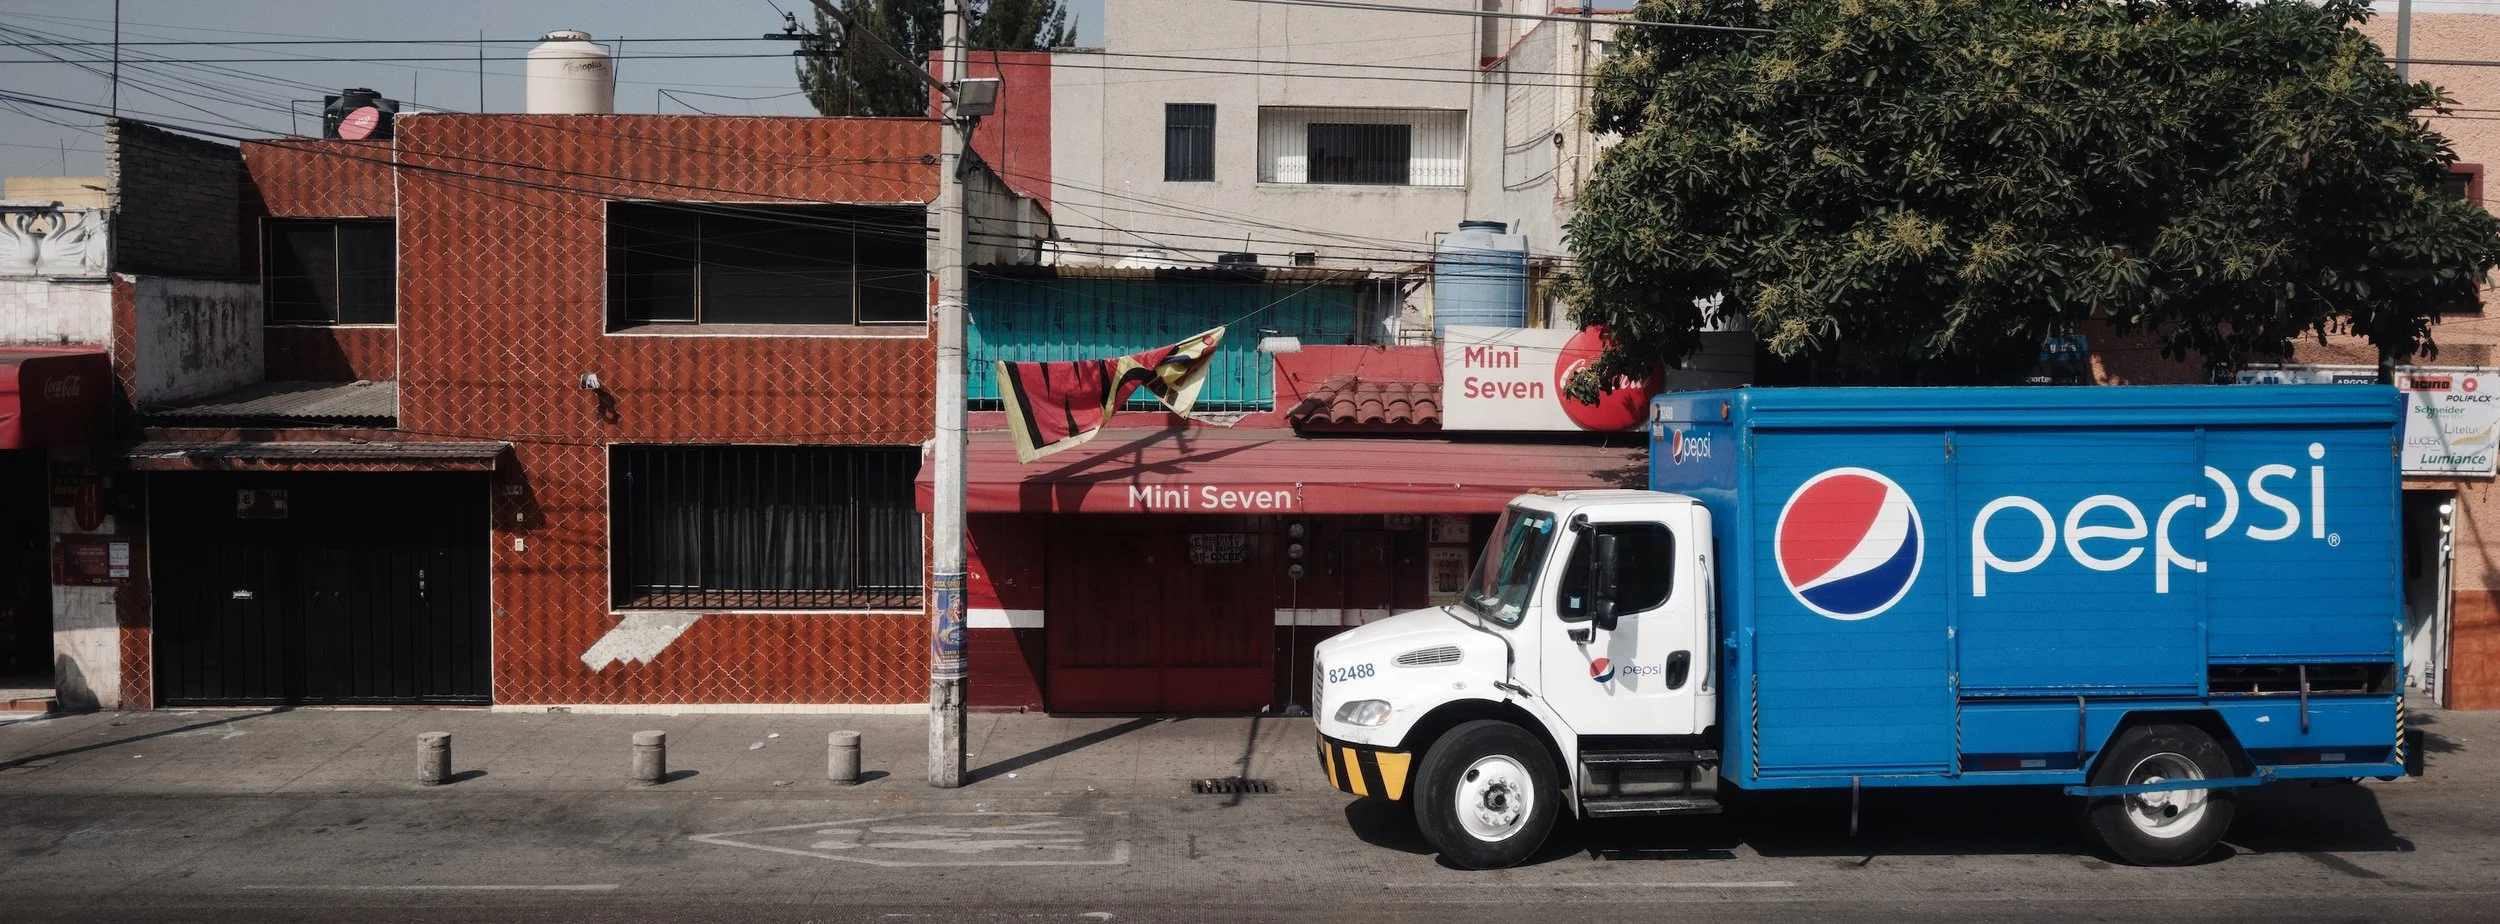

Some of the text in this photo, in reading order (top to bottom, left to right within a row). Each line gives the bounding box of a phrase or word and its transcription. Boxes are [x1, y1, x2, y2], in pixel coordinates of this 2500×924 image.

[1465, 345, 1518, 368] Mini
[1464, 376, 1543, 399] Seven
[2414, 405, 2466, 414] Schneider
[1684, 432, 1711, 463] pepsi
[2421, 453, 2486, 465] Lumiance
[1129, 485, 1291, 509] Mini Seven
[1972, 442, 2326, 597] pepsi
[1329, 663, 1375, 684] 82488
[1623, 664, 1661, 676] pepsi
